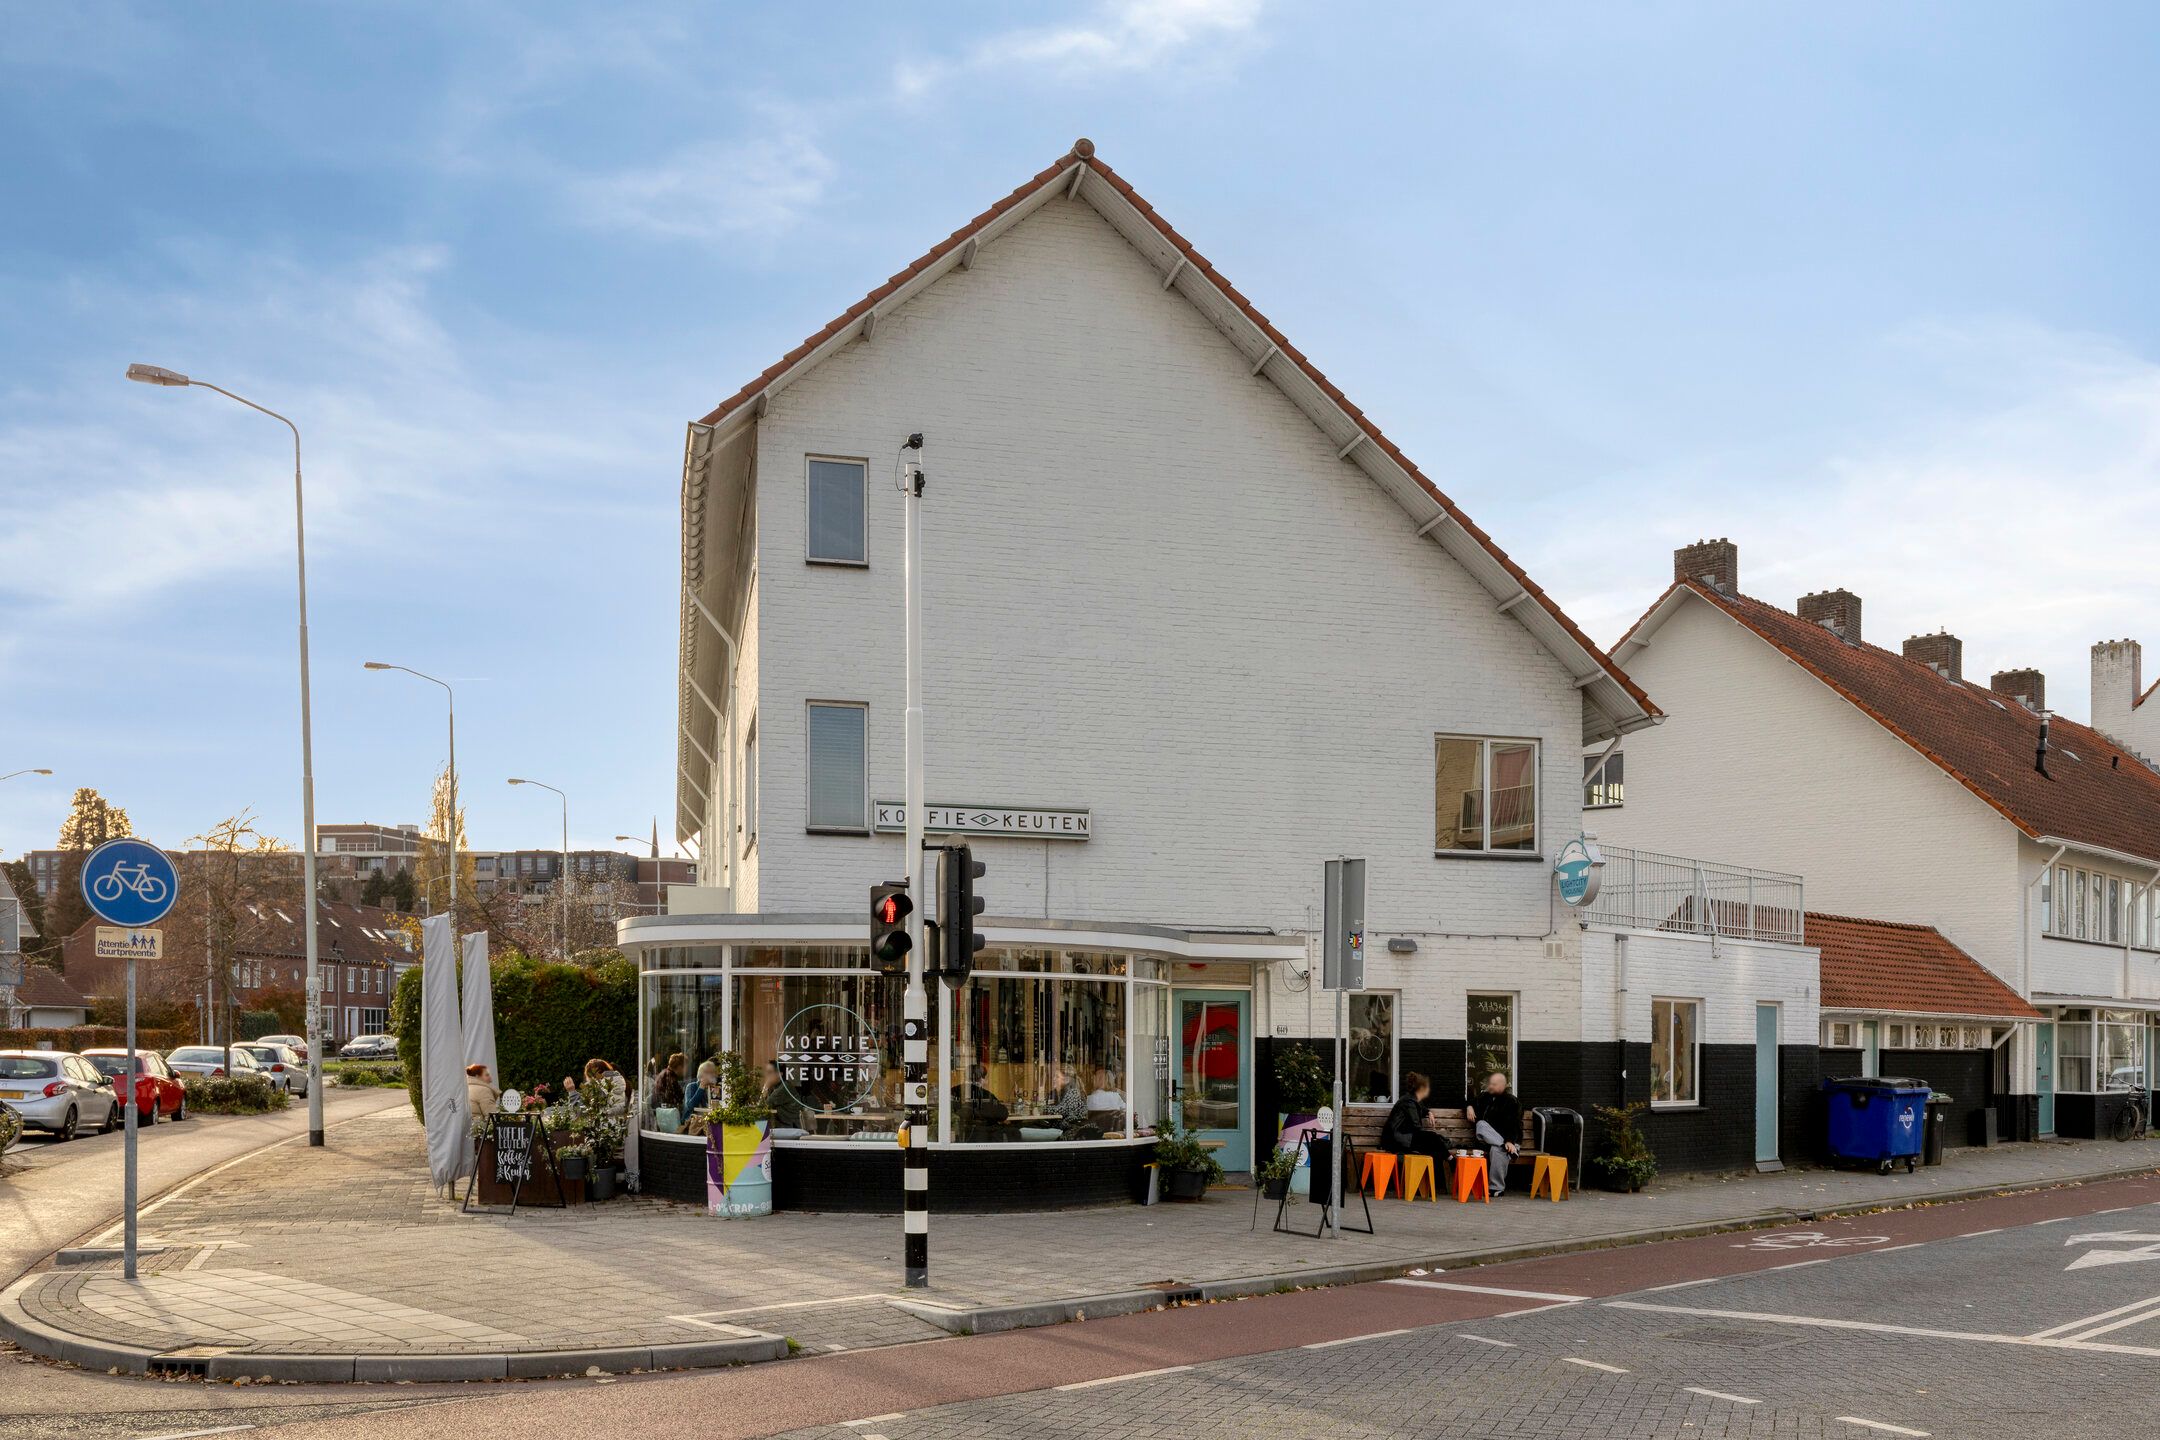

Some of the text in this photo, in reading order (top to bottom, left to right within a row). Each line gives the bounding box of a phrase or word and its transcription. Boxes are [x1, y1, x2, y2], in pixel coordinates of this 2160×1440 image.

[879, 808, 1088, 831] KOFIE KEUTEN
[97, 939, 130, 948] Attentie
[97, 947, 156, 957] Buurtpreventie
[785, 1035, 870, 1050] KOFFIE
[785, 1067, 869, 1082] KEUTEN
[496, 1126, 527, 1140] KOFFIE
